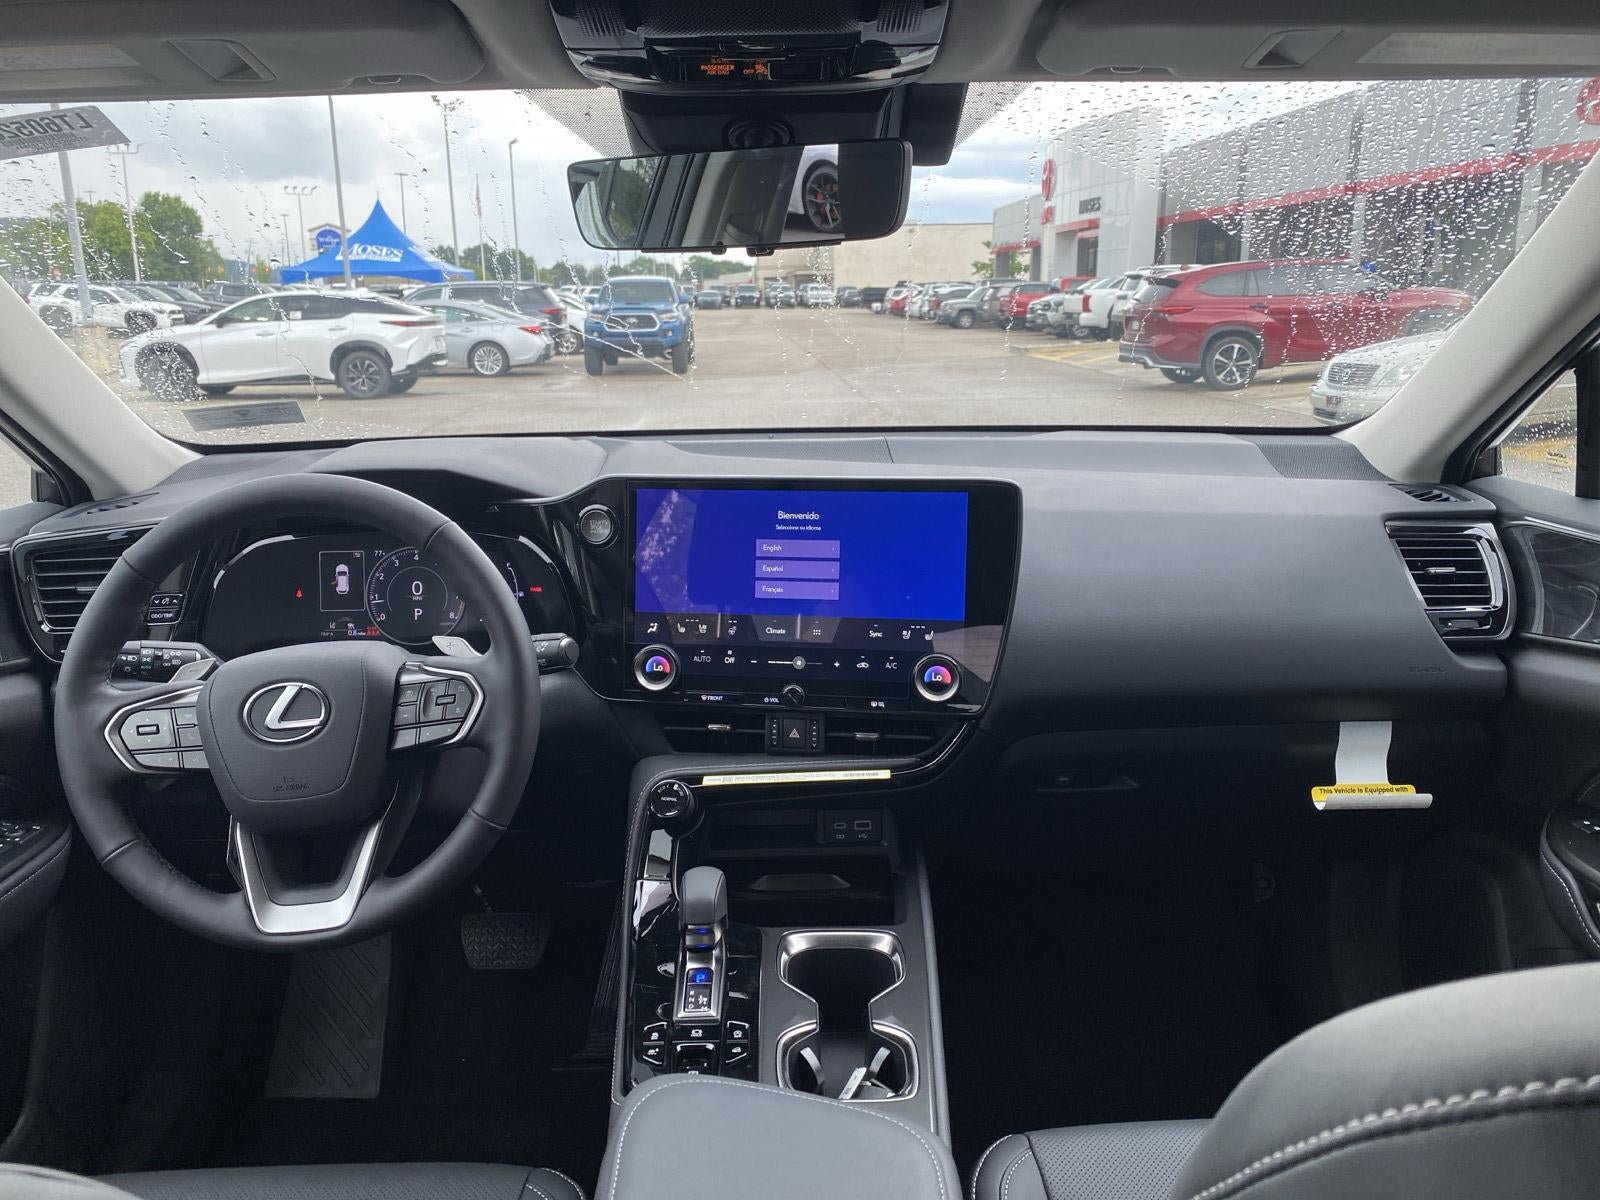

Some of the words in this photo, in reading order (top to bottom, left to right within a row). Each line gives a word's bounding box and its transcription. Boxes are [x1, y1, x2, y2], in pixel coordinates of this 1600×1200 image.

[777, 510, 820, 520] Bienvenido
[413, 553, 419, 561] 4
[412, 581, 423, 595] 0
[379, 613, 386, 621] 0
[414, 609, 422, 620] P
[765, 627, 787, 635] Climate
[869, 629, 883, 638] Sync
[692, 655, 712, 663] AUTO
[724, 656, 735, 664] Off
[654, 663, 664, 671] Lo
[885, 661, 898, 669] A/C
[932, 672, 942, 681] Lo
[1334, 787, 1357, 795] Vehicle
[1364, 786, 1394, 795] Equipped
[696, 973, 705, 982] P
